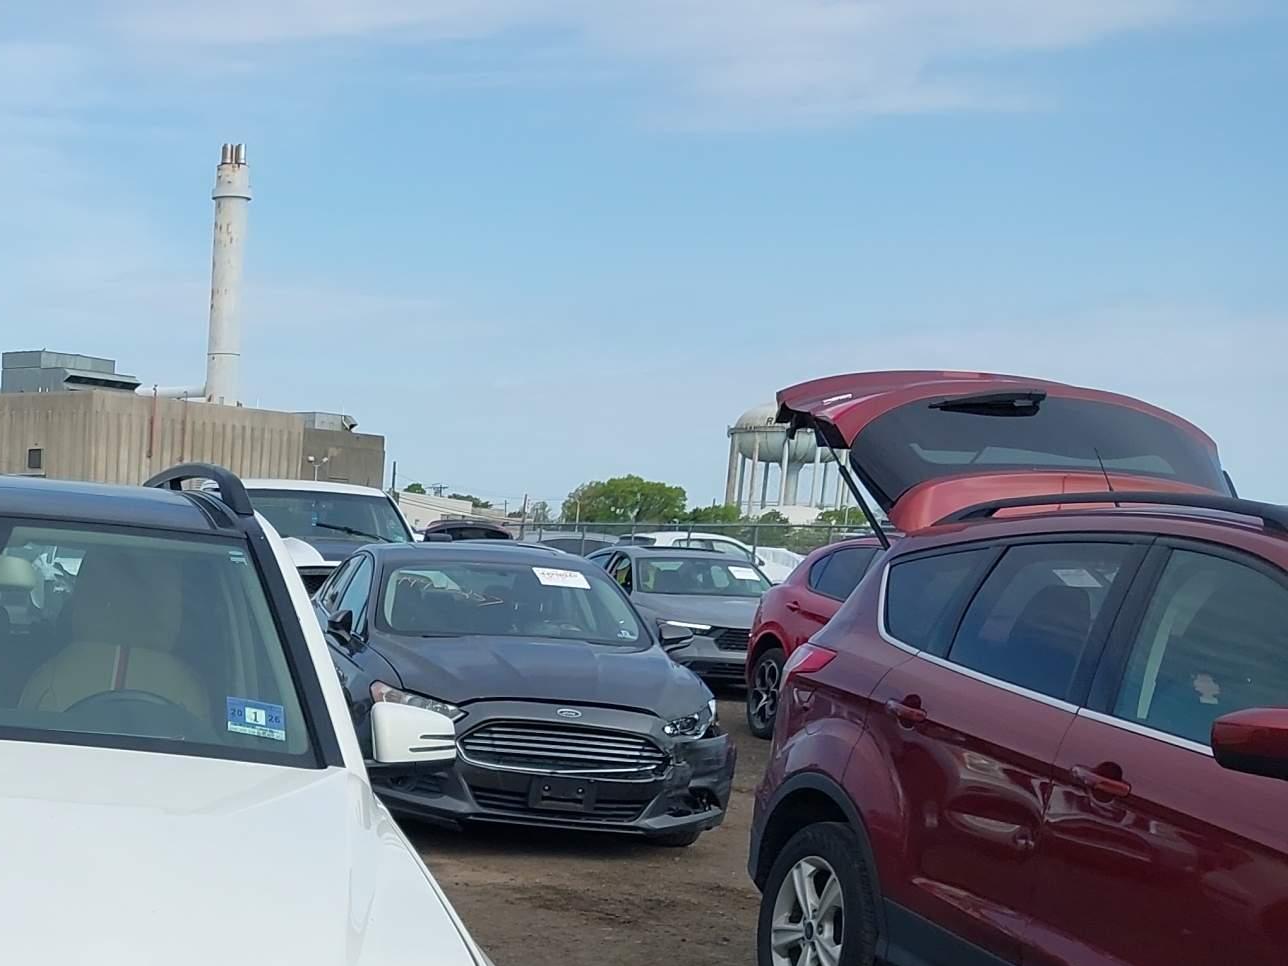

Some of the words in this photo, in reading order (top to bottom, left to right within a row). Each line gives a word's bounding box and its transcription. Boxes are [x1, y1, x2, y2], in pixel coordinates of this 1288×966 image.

[230, 707, 243, 717] 20
[252, 711, 259, 723] 1
[268, 714, 281, 724] 26
